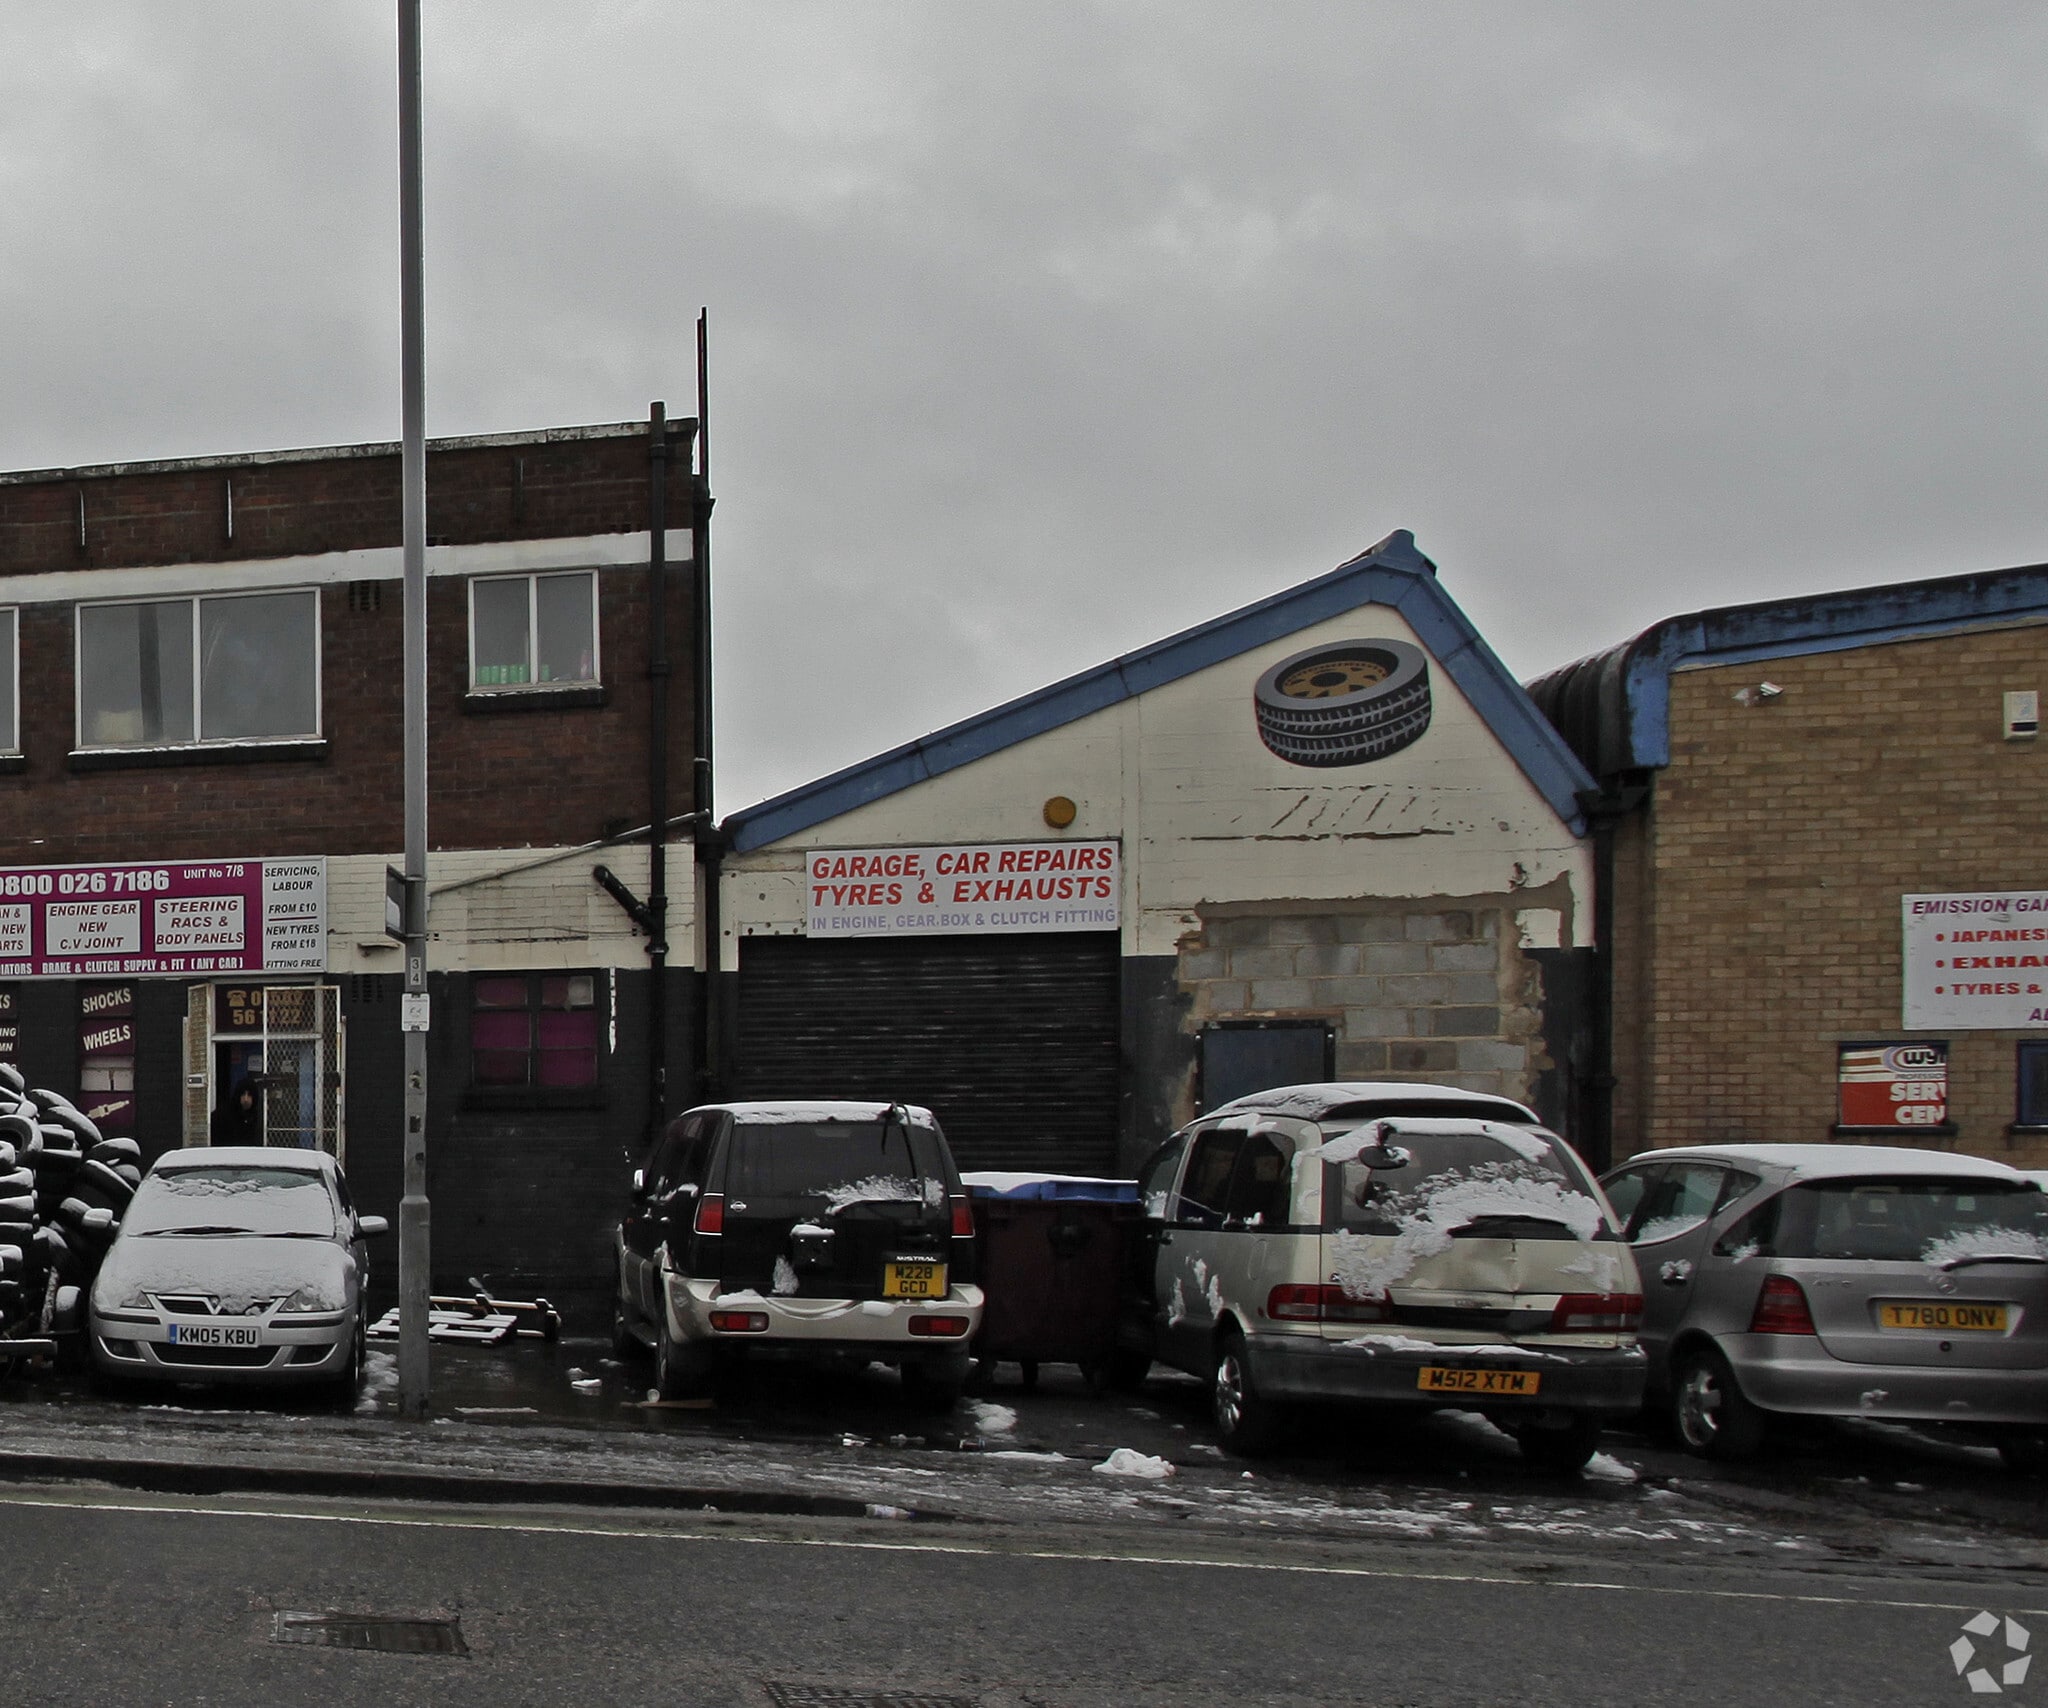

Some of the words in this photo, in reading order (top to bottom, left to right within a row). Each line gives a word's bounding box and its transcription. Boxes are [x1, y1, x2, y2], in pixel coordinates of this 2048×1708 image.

[812, 854, 925, 881] GARAGE,
[936, 851, 990, 875] CAR
[998, 847, 1113, 873] REPAIRS
[184, 869, 206, 880] UNIT
[209, 868, 223, 879] No
[225, 864, 244, 878] 7/8
[264, 866, 320, 878] SERVICING,
[0, 874, 53, 896] 800
[59, 872, 107, 894] 026
[111, 870, 170, 893] 7186
[272, 880, 313, 892] LABOUR
[811, 883, 904, 907] TYRES
[917, 881, 935, 904] &
[953, 876, 1112, 903] EXHAUSTS
[13, 908, 21, 919] &
[50, 904, 98, 917] ENGINE
[102, 903, 137, 915] GEAR
[159, 900, 238, 914] STEERING
[268, 903, 297, 914] FROM
[299, 902, 317, 913] £10
[1912, 899, 2009, 915] EMISSION
[170, 917, 213, 929] RACS
[218, 916, 229, 927] &
[811, 917, 827, 930] IN
[832, 914, 891, 930] ENGINE,
[974, 913, 986, 926] &
[990, 911, 1050, 926] CLUTCH
[1054, 908, 1116, 924] FITTING
[1, 924, 26, 935] NEW
[78, 921, 107, 933] NEW
[266, 926, 289, 936] NEW
[290, 924, 320, 934] TYRES
[156, 933, 191, 945] BODY
[194, 932, 244, 944] PANELS
[1951, 928, 2048, 943] JAPANES
[0, 940, 24, 951] RTS
[60, 939, 82, 950] C.V
[85, 937, 124, 949] JOINT
[270, 939, 297, 950] FROM
[42, 961, 71, 974] BRAKE
[74, 962, 82, 973] &
[85, 960, 120, 972] CLUTCH
[124, 959, 157, 972] SUPPLY
[160, 961, 168, 971] &
[171, 958, 185, 970] FIT
[265, 959, 299, 968] FITTING
[300, 958, 322, 968] FREE
[412, 959, 420, 970] 3
[1952, 955, 2048, 969] EXHA
[412, 972, 420, 984] 4
[1951, 983, 2020, 996] TYRES
[2026, 983, 2043, 994] &
[82, 988, 132, 1014] SHOCKS
[83, 1024, 131, 1051] WHEELS
[900, 1281, 928, 1294] GCD
[1891, 1306, 1949, 1325] T780
[1955, 1308, 1998, 1326] ONV
[179, 1327, 220, 1344] KM05
[225, 1329, 257, 1345] KBU
[1430, 1370, 1477, 1388] M512
